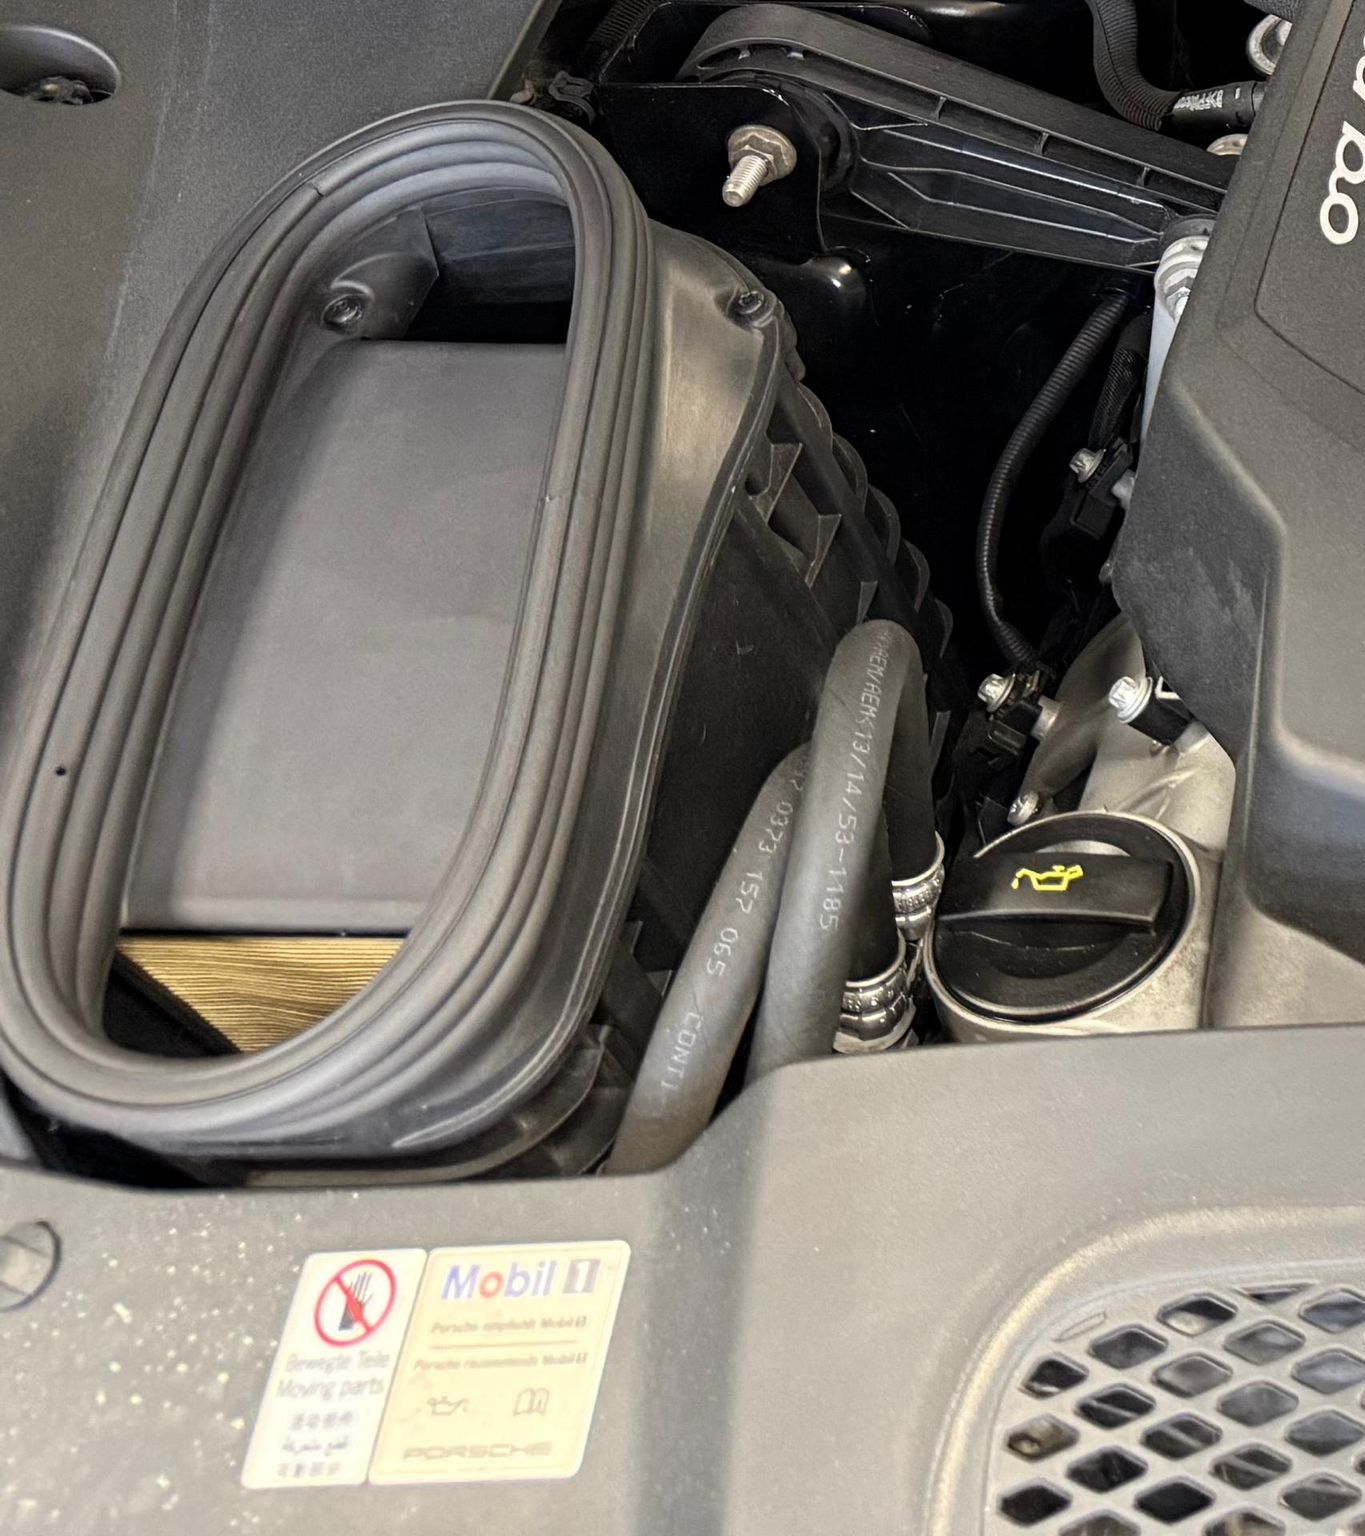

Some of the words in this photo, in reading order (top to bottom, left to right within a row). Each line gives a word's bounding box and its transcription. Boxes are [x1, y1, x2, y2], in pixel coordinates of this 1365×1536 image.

[757, 801, 794, 855] 0373
[735, 871, 764, 915] 157
[706, 927, 739, 977] 065
[441, 1260, 557, 1301] Mobil
[276, 1378, 337, 1402] Moving
[338, 1377, 385, 1400] parts
[402, 1442, 553, 1461] PORSCHE
